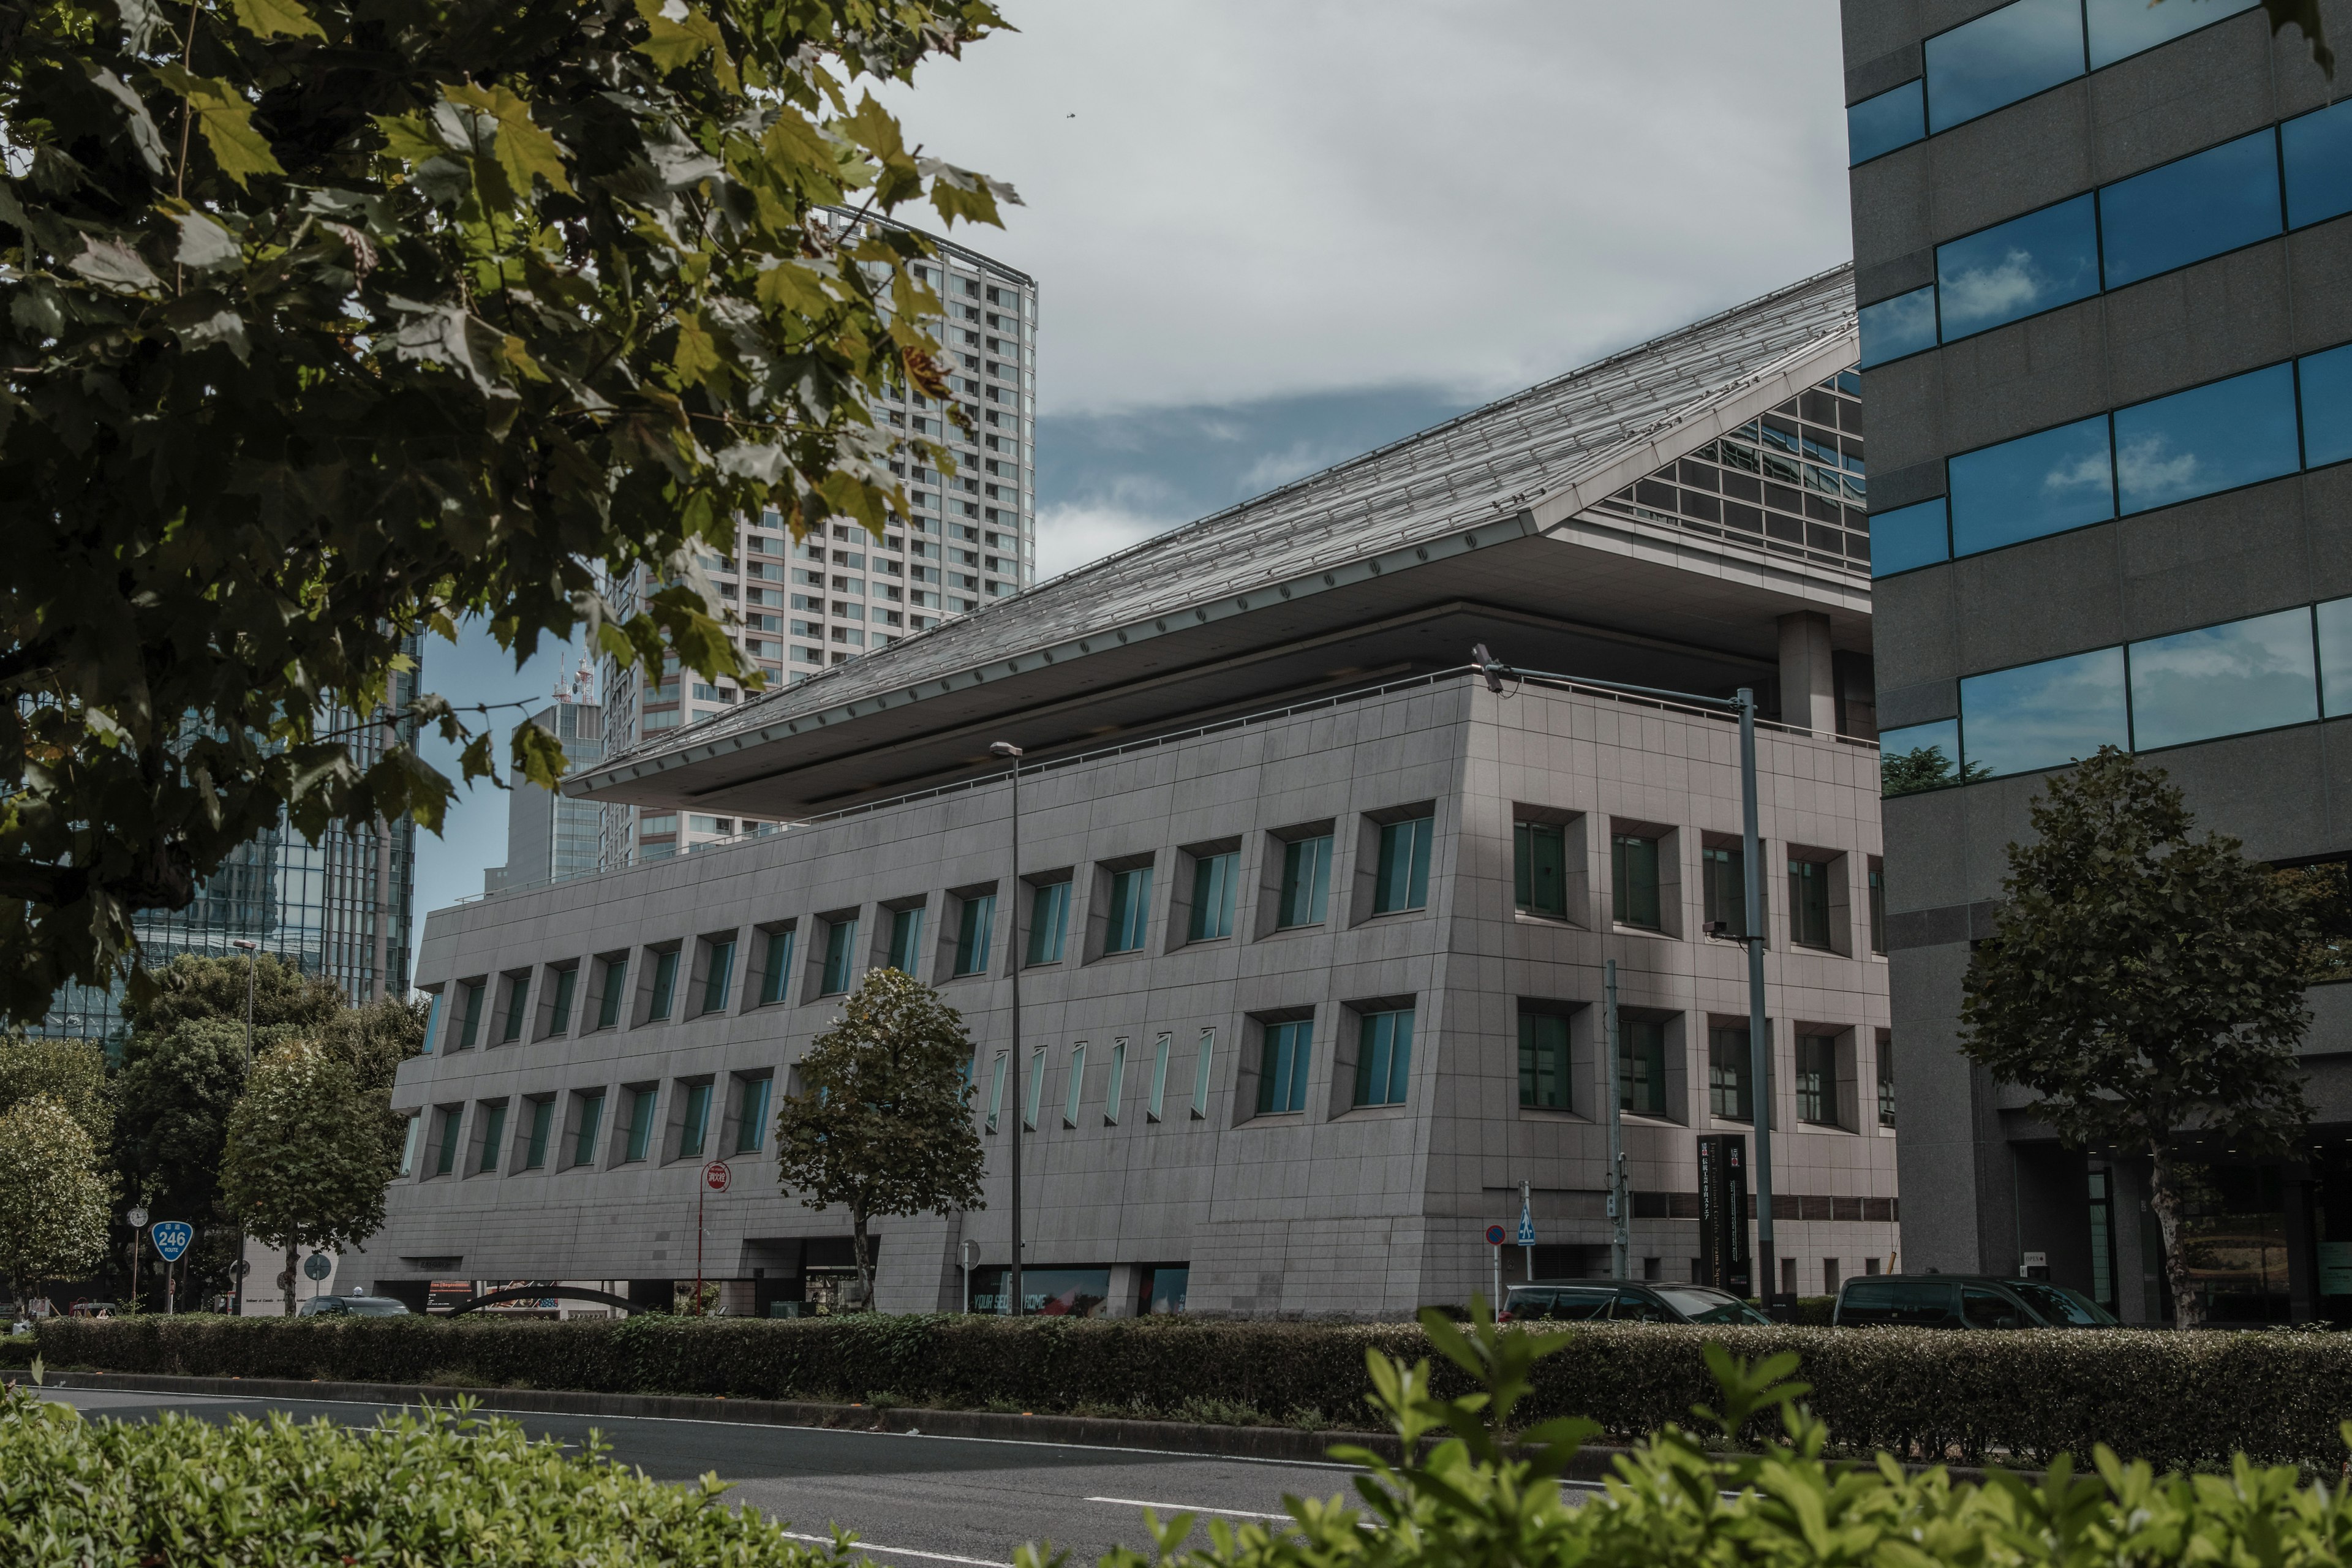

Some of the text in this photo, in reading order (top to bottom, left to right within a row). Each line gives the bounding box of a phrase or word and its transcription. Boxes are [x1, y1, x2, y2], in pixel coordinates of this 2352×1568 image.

[708, 1172, 725, 1182] 消火栓
[159, 1231, 186, 1246] 246
[974, 1294, 993, 1310] YOUR
[1024, 1294, 1046, 1310] HOME
